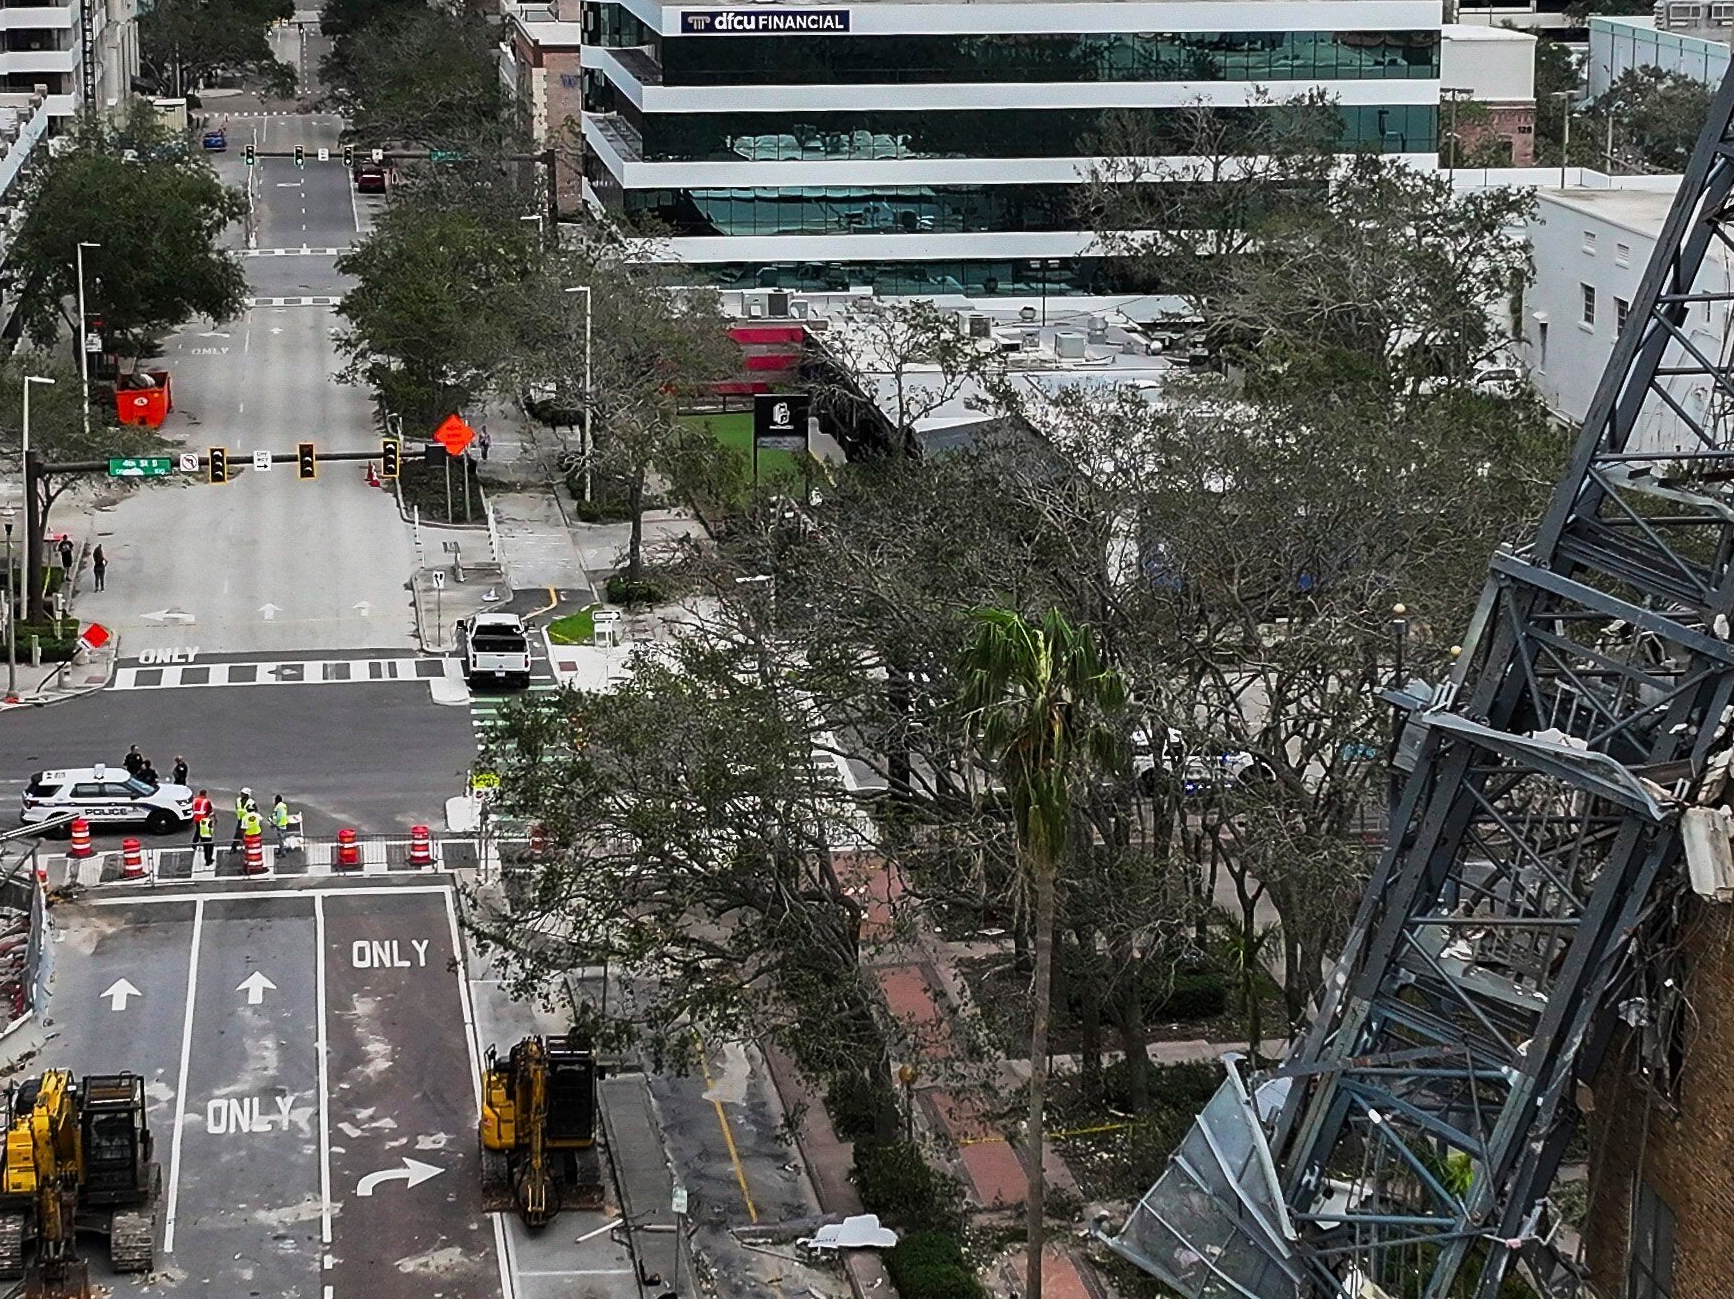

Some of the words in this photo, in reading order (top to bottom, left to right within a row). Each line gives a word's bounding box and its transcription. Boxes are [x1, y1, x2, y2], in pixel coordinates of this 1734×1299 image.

[715, 12, 756, 30] dfcu
[759, 14, 845, 30] FINANCIAL
[139, 646, 199, 664] ONLY
[85, 808, 128, 816] POLICE
[352, 940, 429, 968] ONLY
[207, 1096, 296, 1136] ONLY
